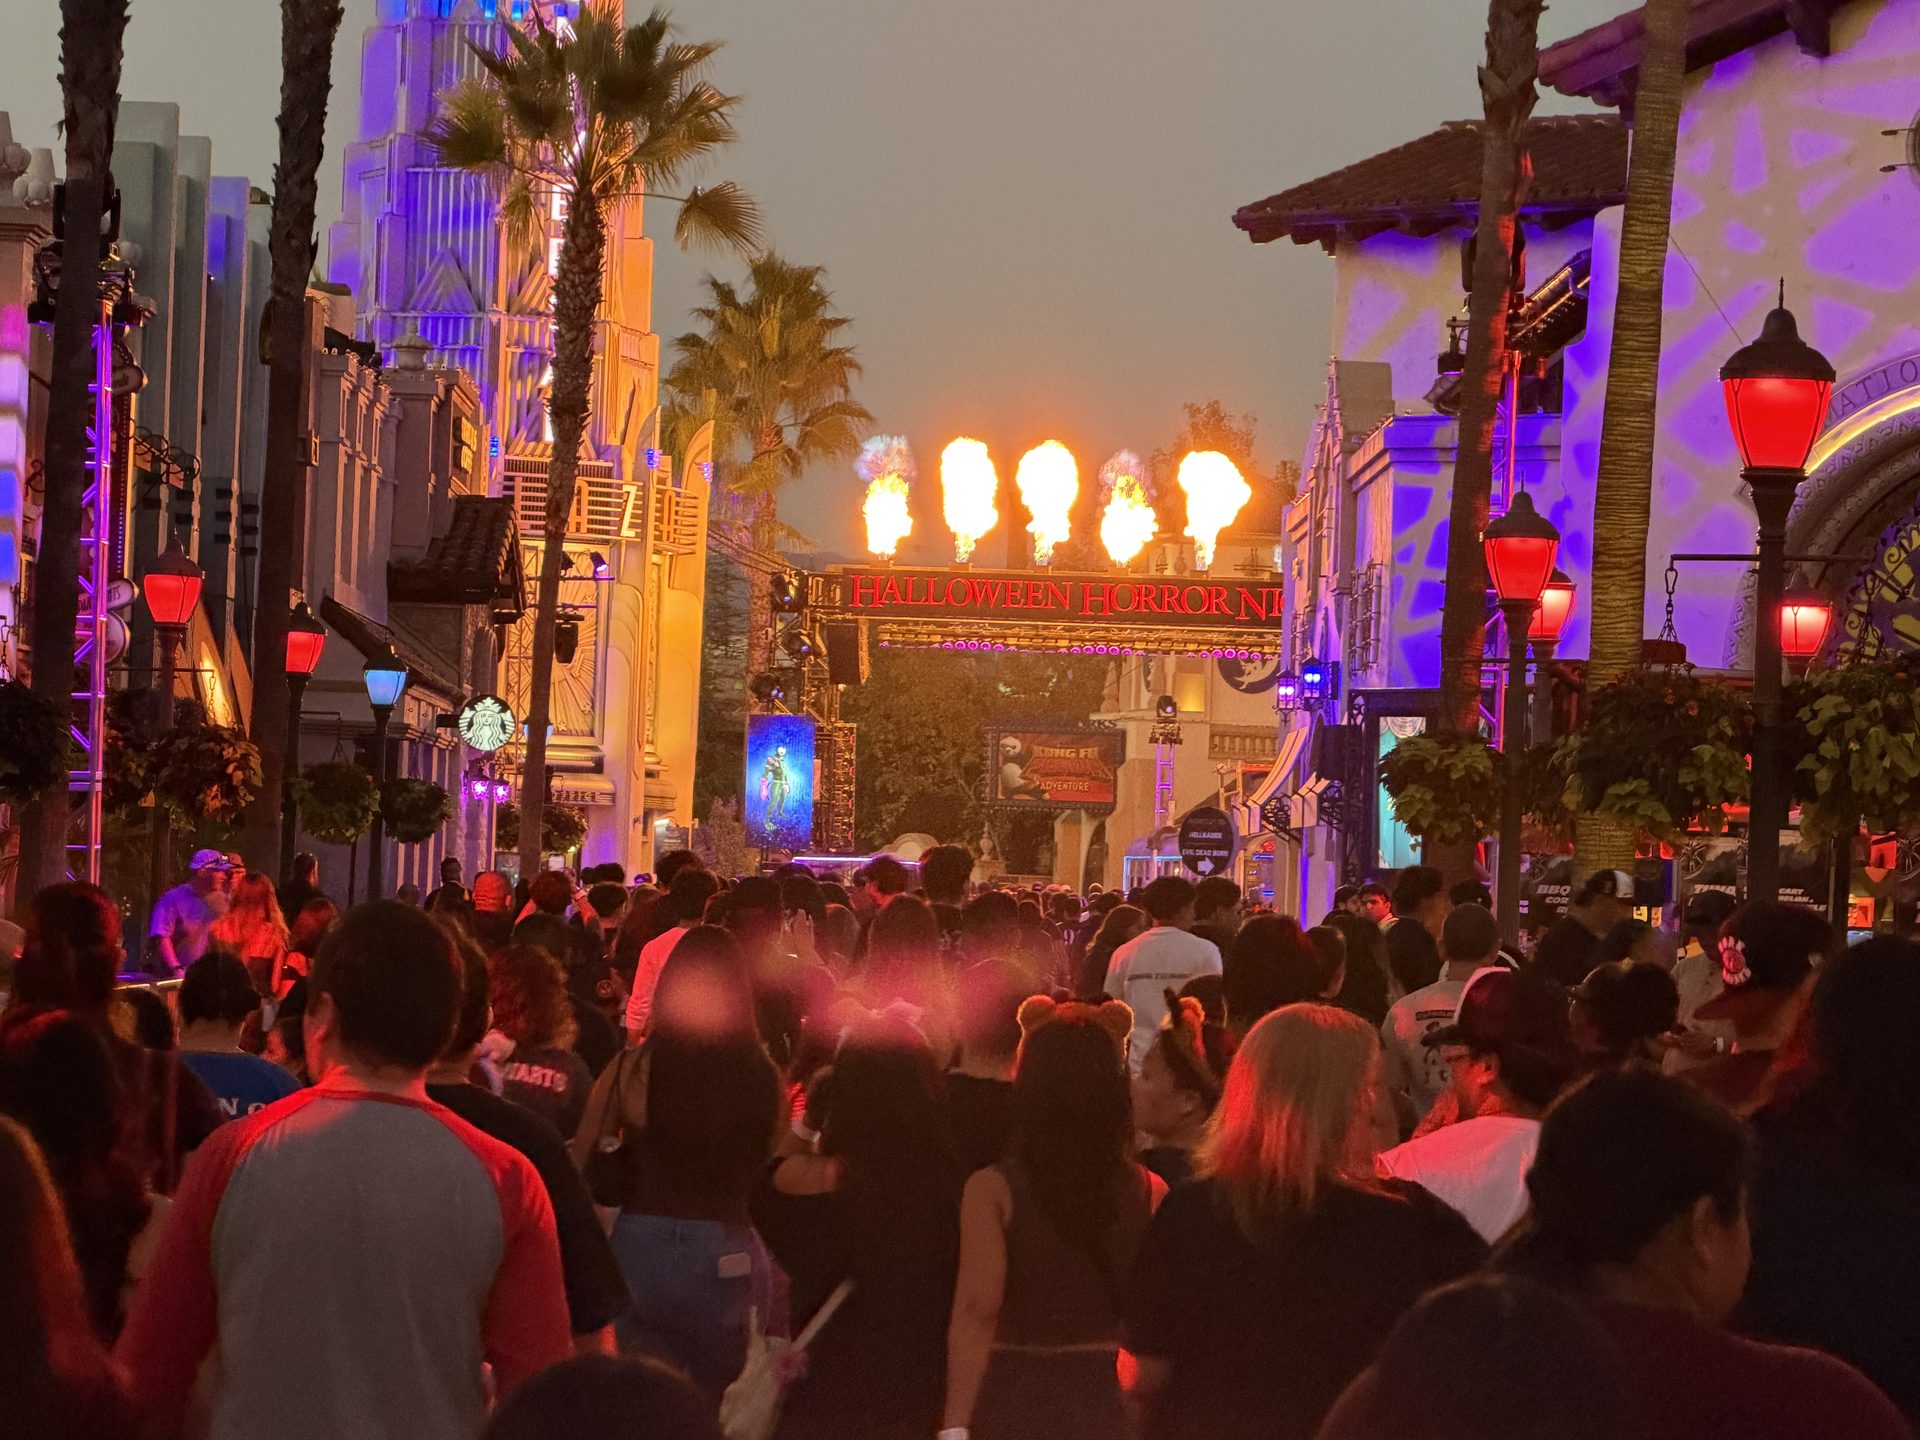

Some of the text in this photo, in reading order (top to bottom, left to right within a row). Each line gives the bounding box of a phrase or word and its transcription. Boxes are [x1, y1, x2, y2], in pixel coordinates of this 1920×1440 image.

[1831, 360, 1919, 419] ATIO
[847, 574, 1284, 621] HALLOWEEN HORROR NI
[1040, 781, 1089, 792] ADVENTURE
[1536, 884, 1571, 896] BBQ
[1545, 896, 1570, 904] COR
